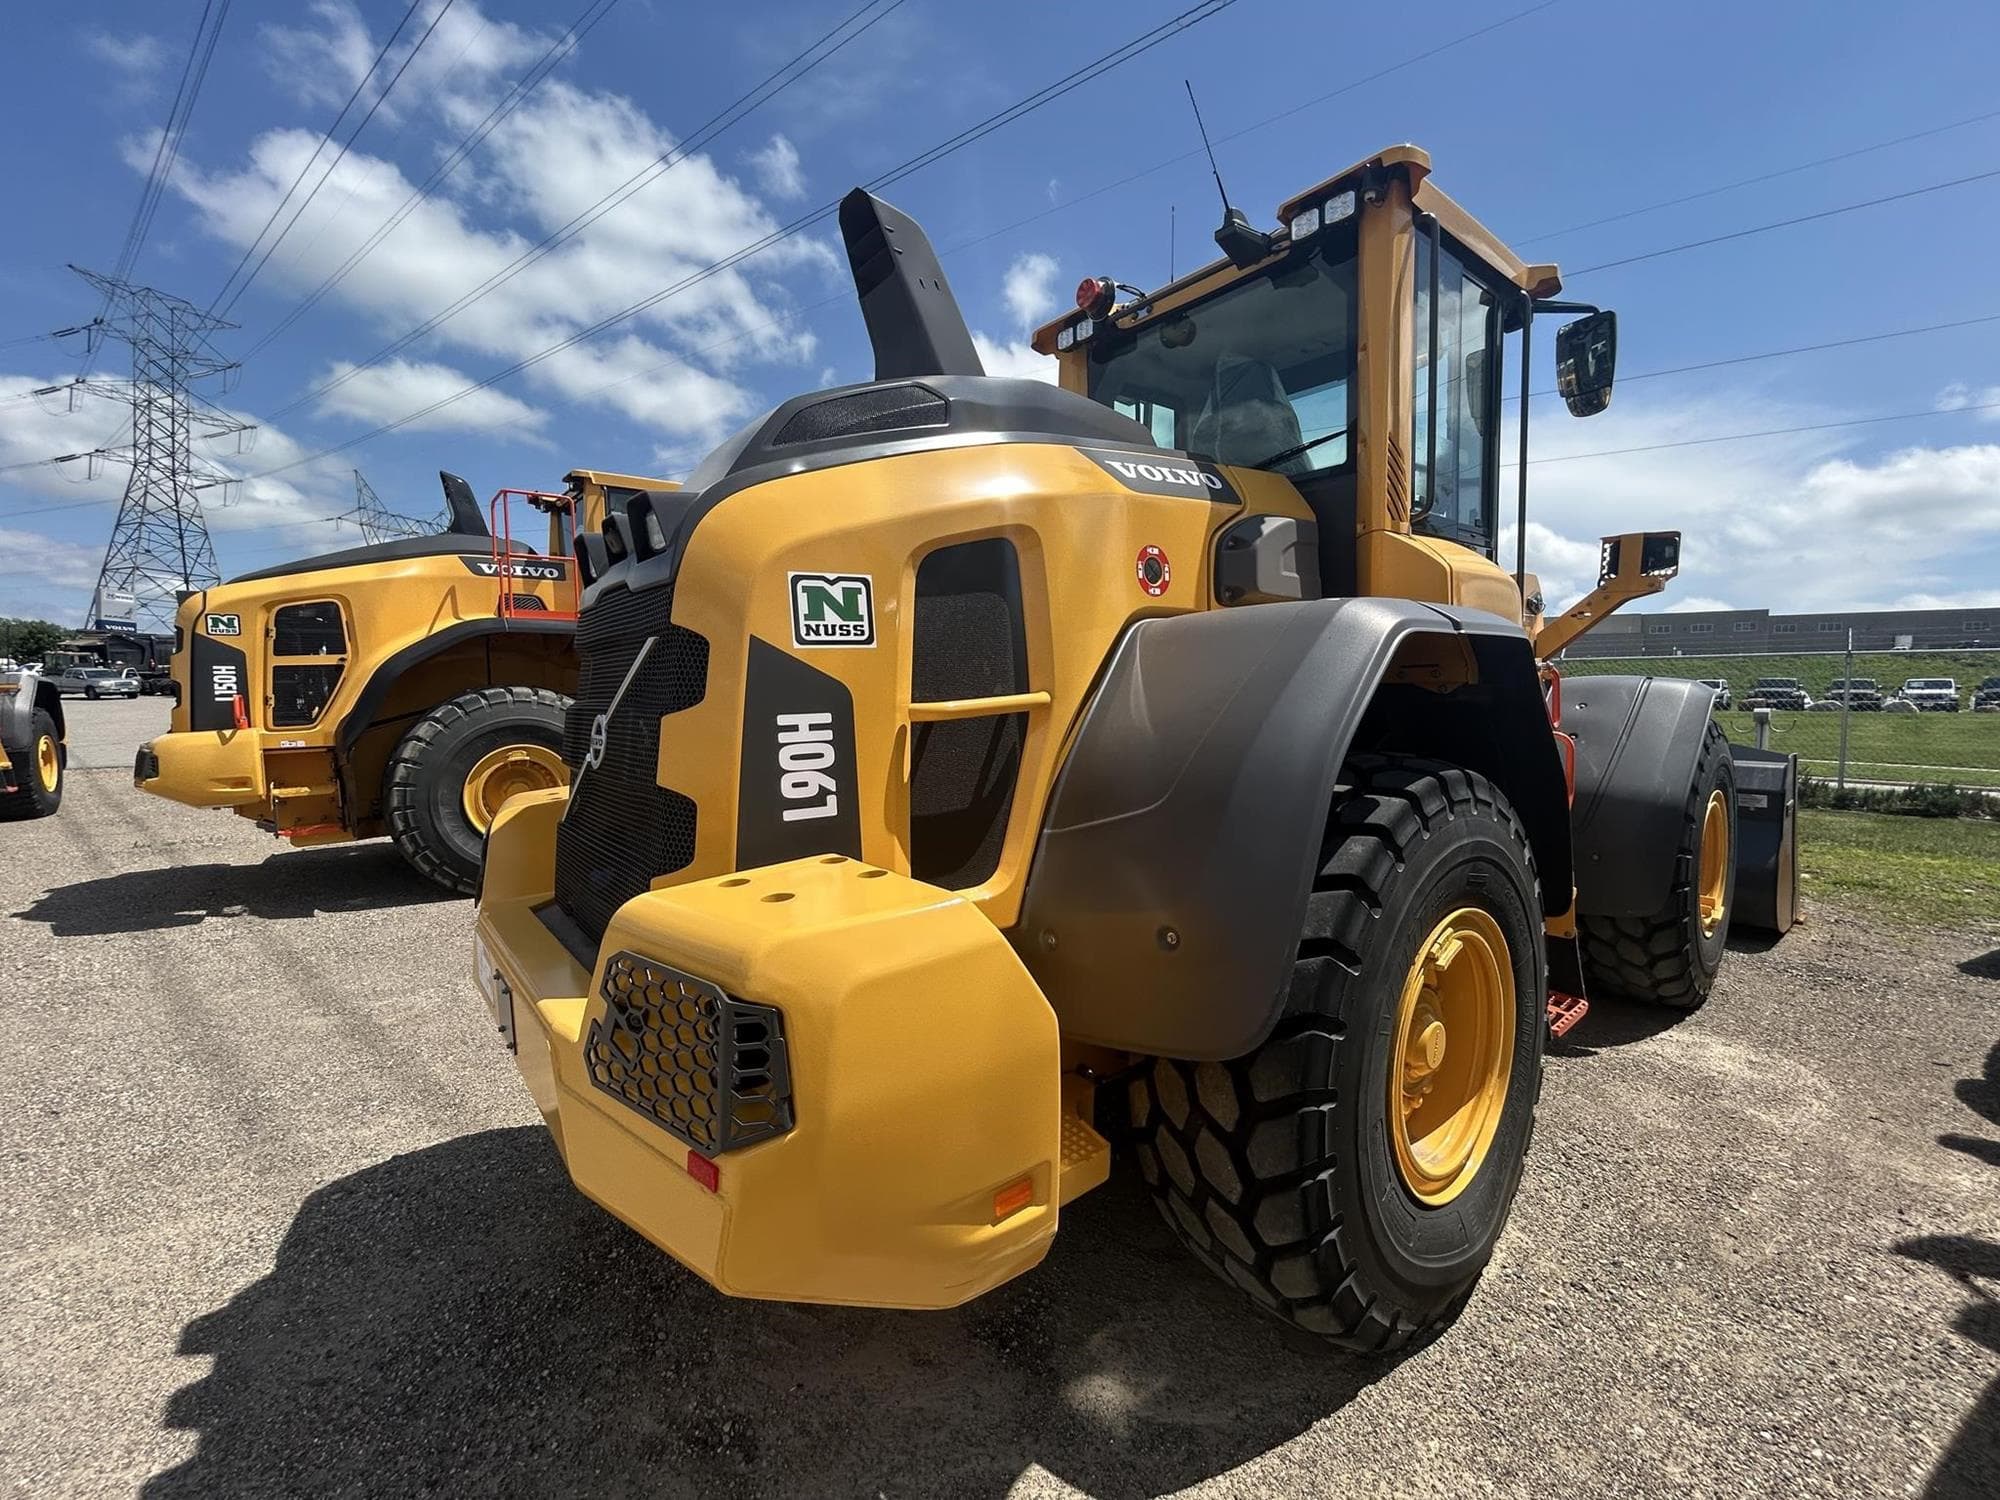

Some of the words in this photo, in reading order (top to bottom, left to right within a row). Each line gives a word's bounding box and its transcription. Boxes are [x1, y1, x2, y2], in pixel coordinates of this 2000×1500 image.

[1104, 459, 1222, 489] VOLVO
[477, 563, 559, 578] VOLVO
[804, 623, 865, 637] NUSS
[777, 713, 837, 821] L90H
